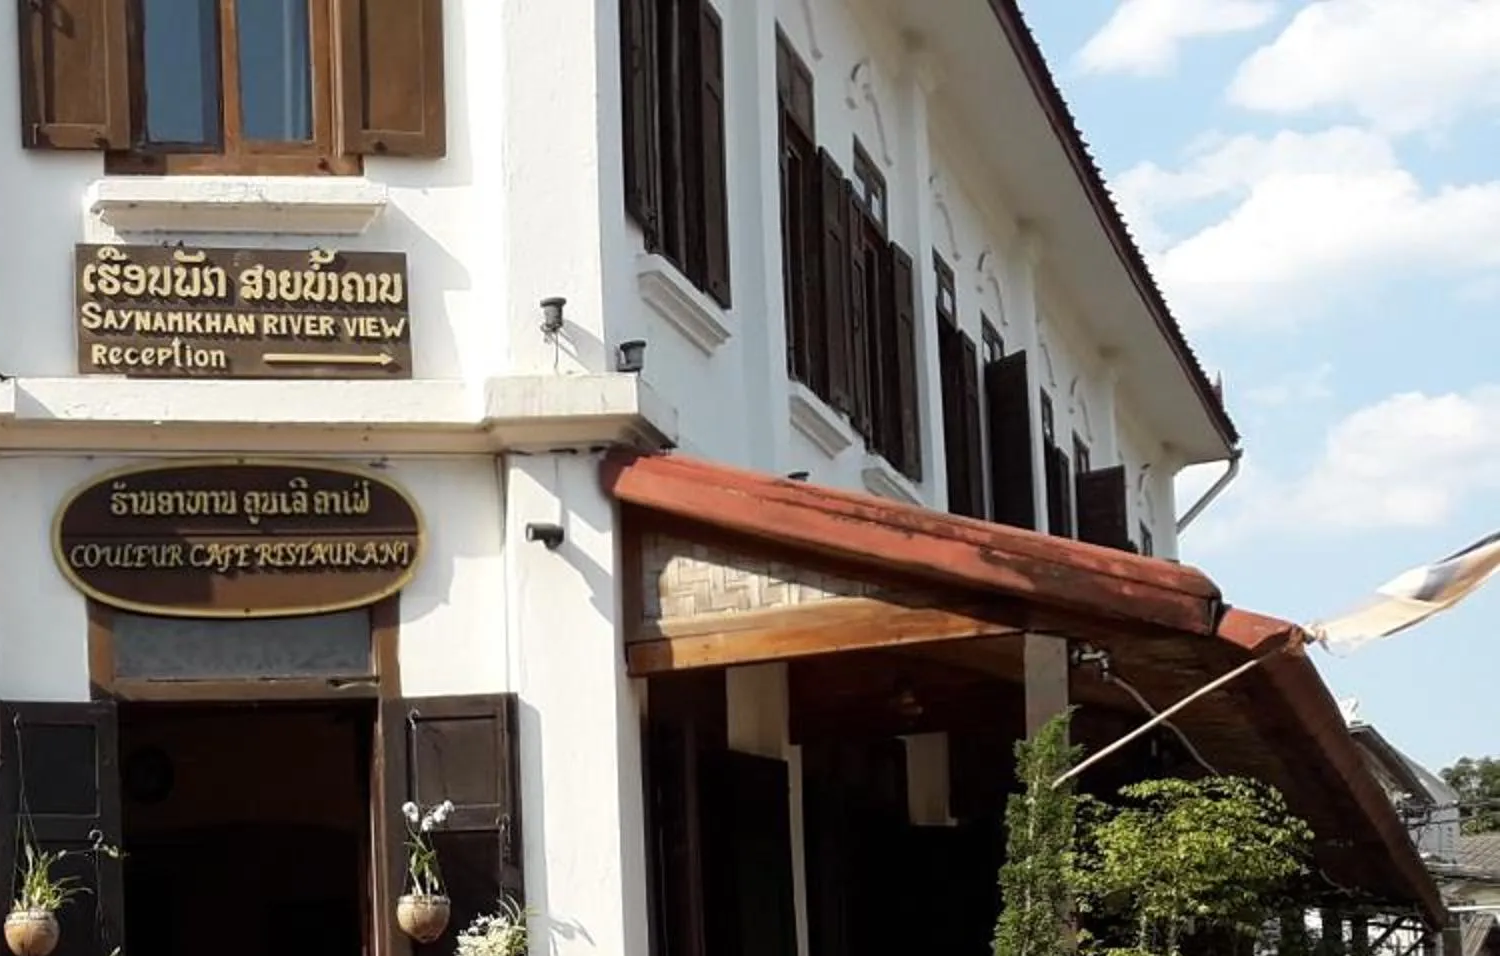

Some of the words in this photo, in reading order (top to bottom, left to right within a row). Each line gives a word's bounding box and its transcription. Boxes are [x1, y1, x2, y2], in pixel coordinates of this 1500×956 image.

[81, 301, 255, 336] SAYNAMKHAN
[263, 314, 335, 337] RIVER
[343, 316, 406, 339] VIEW
[70, 543, 184, 568] COULEUR
[189, 543, 250, 574] CAFE
[254, 541, 410, 567] RESTAURANT
